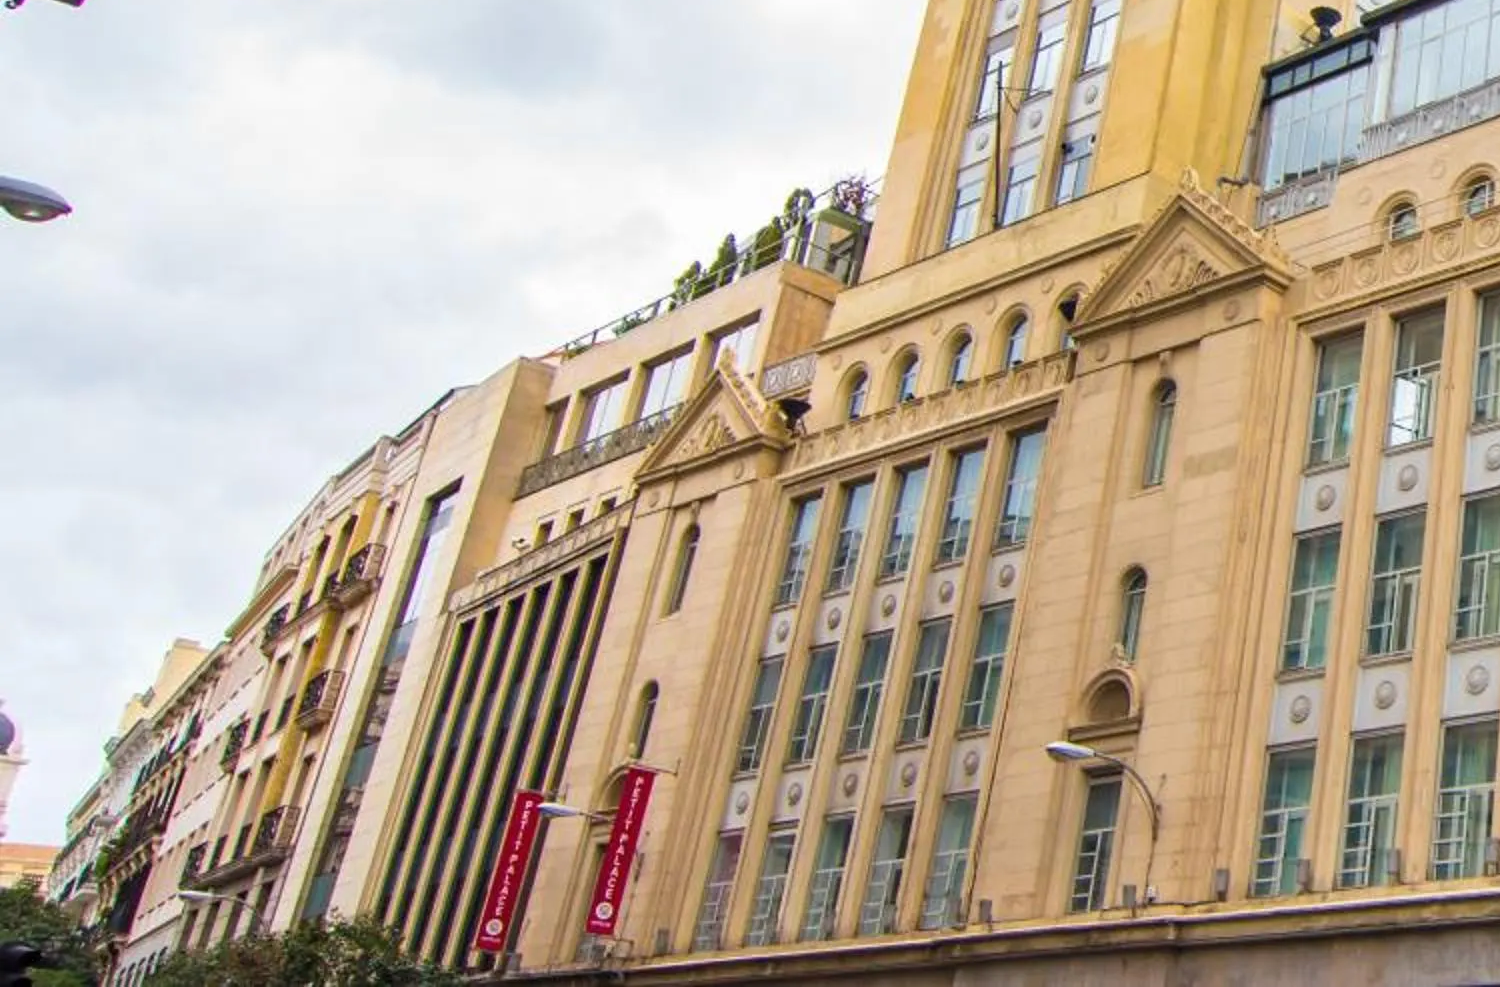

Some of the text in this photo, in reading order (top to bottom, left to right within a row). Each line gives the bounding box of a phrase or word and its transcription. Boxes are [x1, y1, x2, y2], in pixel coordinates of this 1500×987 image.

[495, 800, 534, 916] PETIT PALACE
[605, 776, 645, 900] PETIT PALACE
